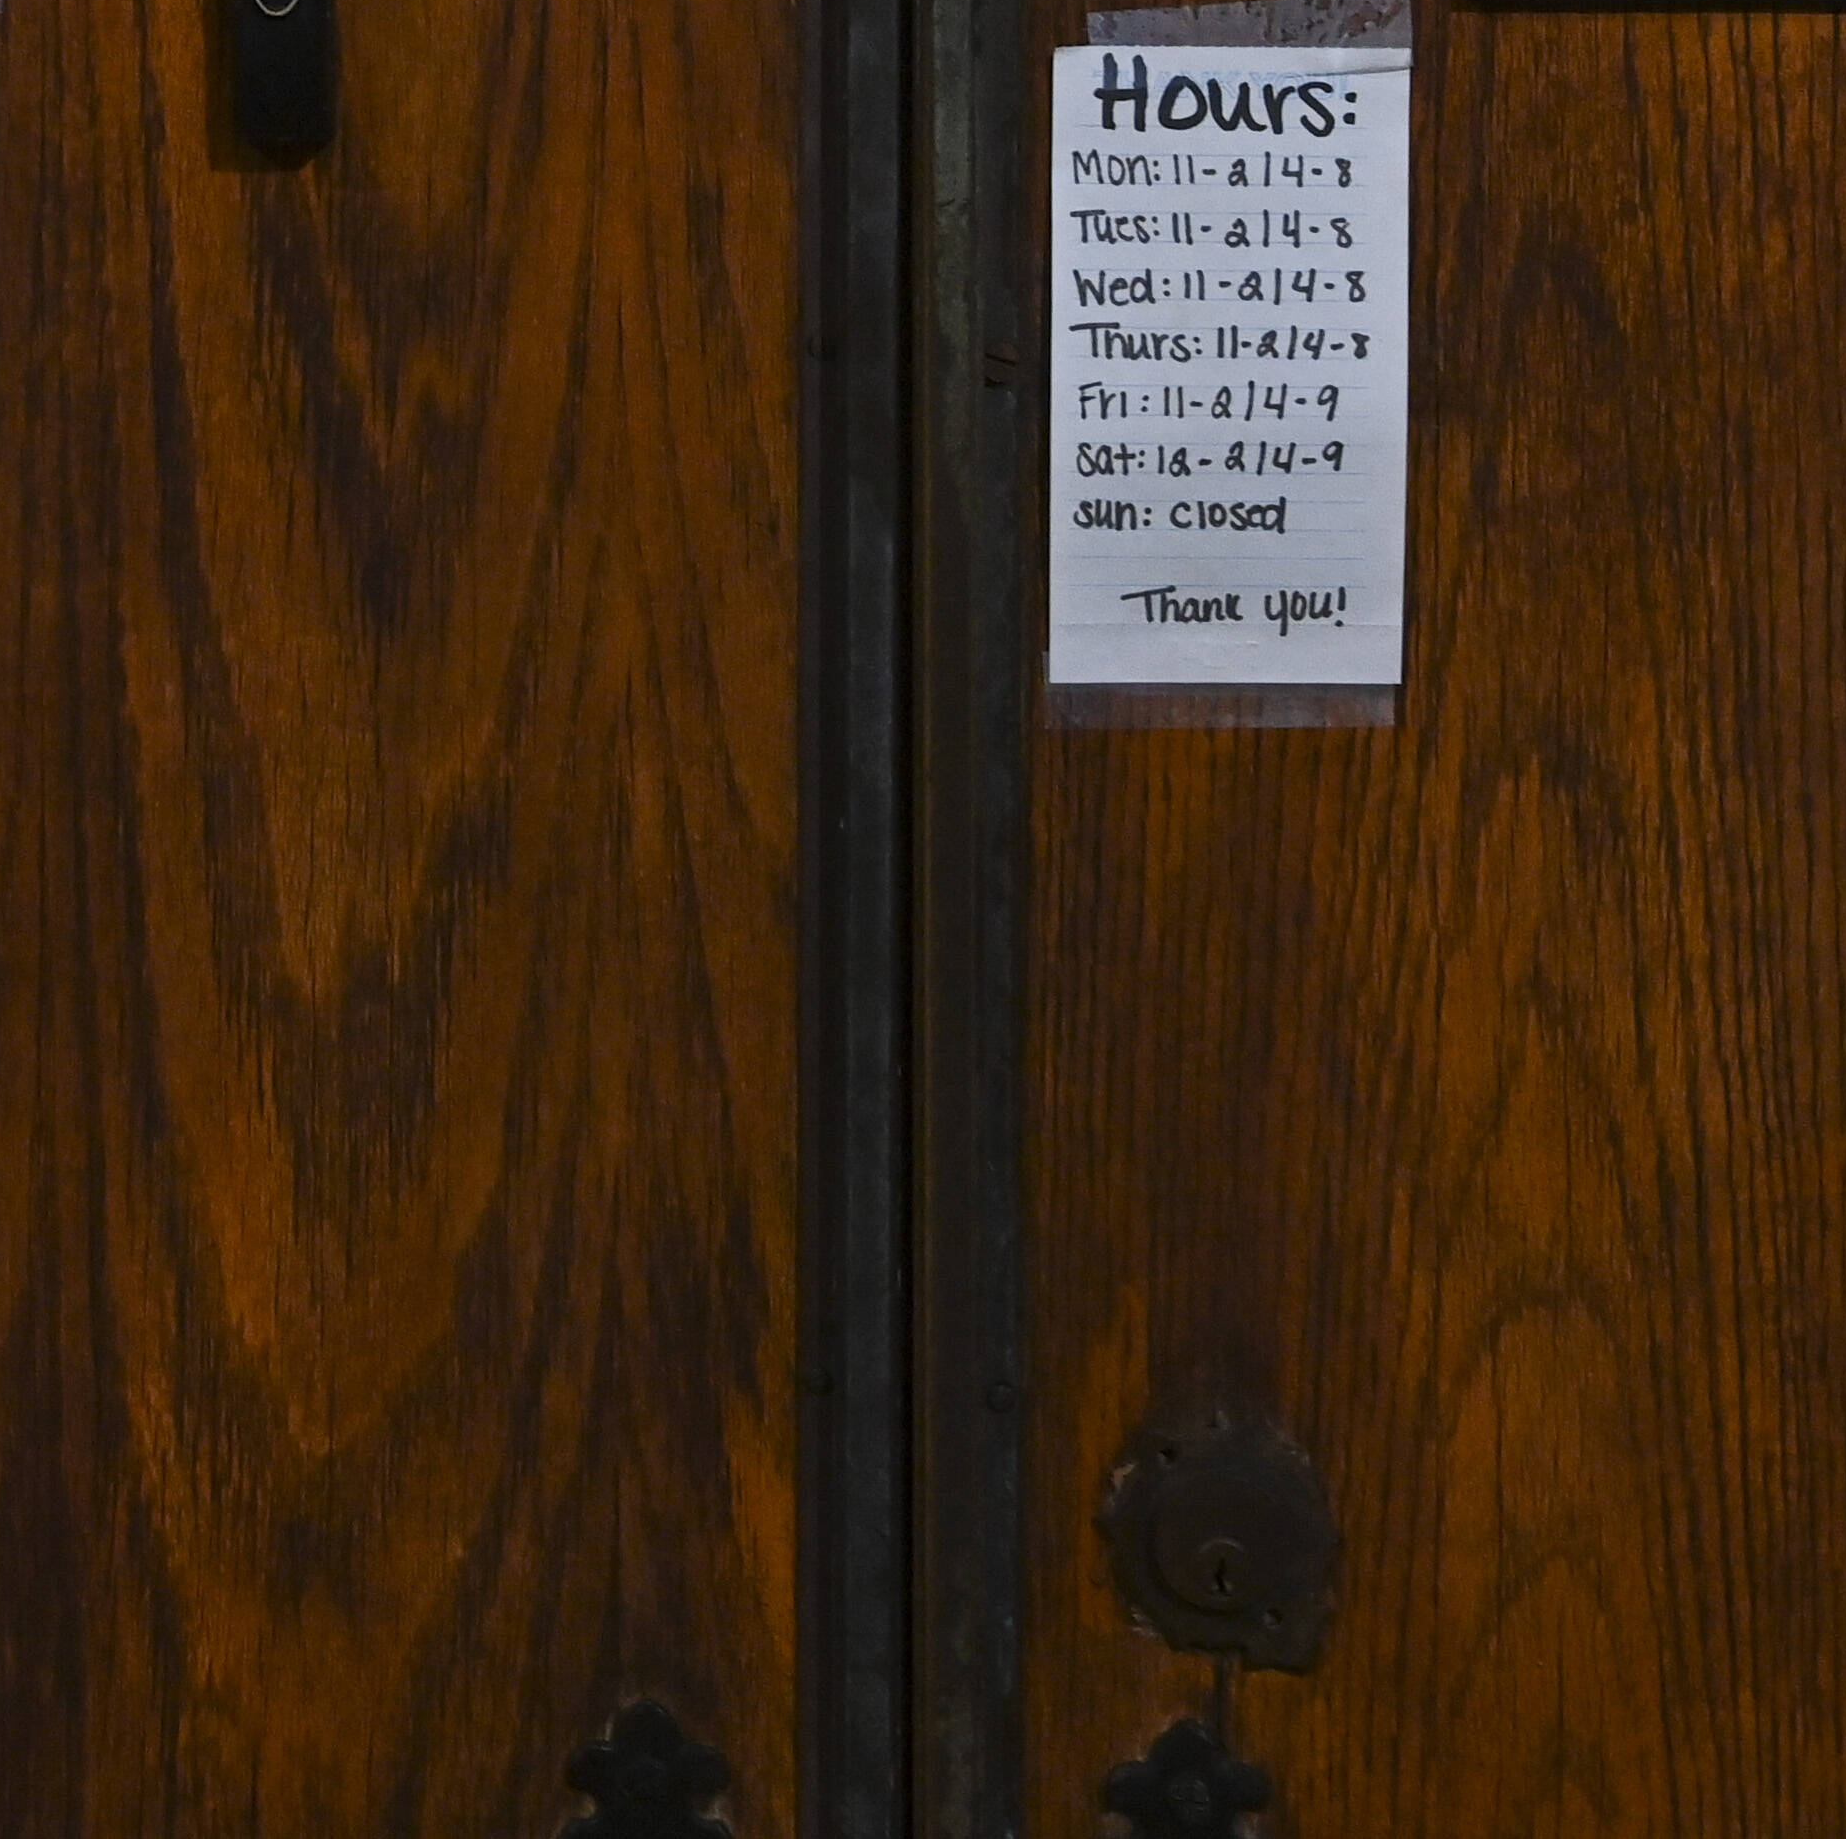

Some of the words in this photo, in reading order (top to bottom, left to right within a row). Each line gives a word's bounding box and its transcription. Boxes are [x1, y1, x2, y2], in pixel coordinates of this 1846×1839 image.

[1093, 52, 1357, 138] Hours:
[1072, 149, 1160, 187] Mon:
[1069, 209, 1158, 245] Tues:
[1072, 268, 1170, 307] Wed:
[1068, 322, 1200, 363] Thurs:
[1078, 381, 1150, 420] Fri:
[1169, 496, 1287, 535] closed
[1120, 584, 1244, 624] Thank
[1264, 586, 1347, 637] you!
